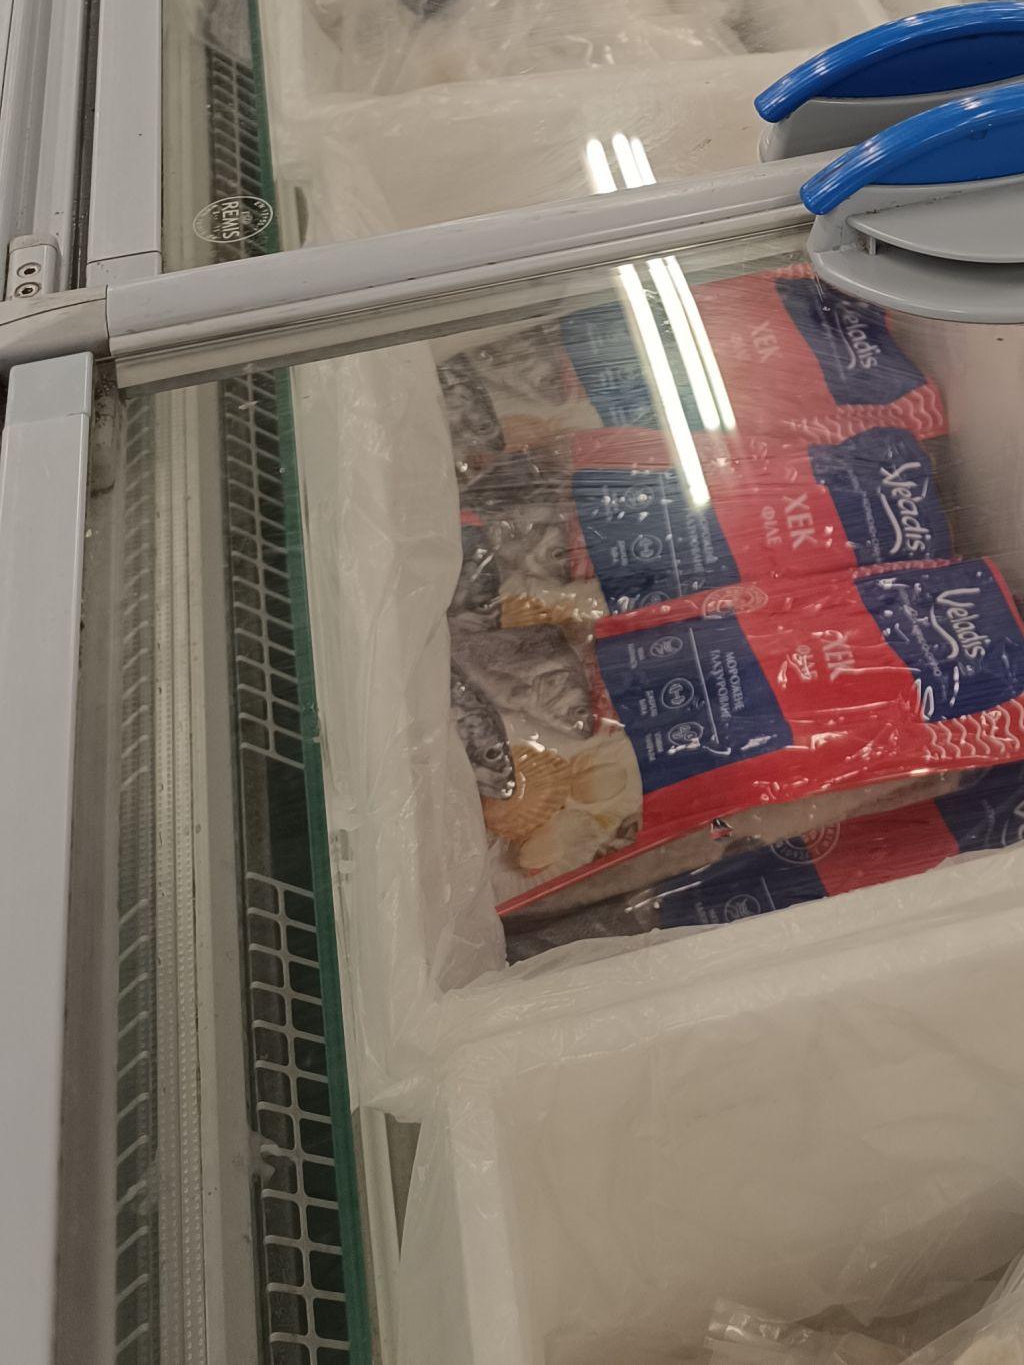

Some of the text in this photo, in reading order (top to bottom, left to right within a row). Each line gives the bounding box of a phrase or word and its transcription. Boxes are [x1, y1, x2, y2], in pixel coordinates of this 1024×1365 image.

[222, 201, 240, 239] REMIS
[761, 505, 782, 546] ФІЛЕ
[782, 492, 818, 550] ХЕК
[882, 461, 931, 552] Veladis
[937, 587, 990, 659] Veladis
[725, 651, 744, 711] МОРОЖЕНЕ
[822, 636, 855, 681] ХЕК
